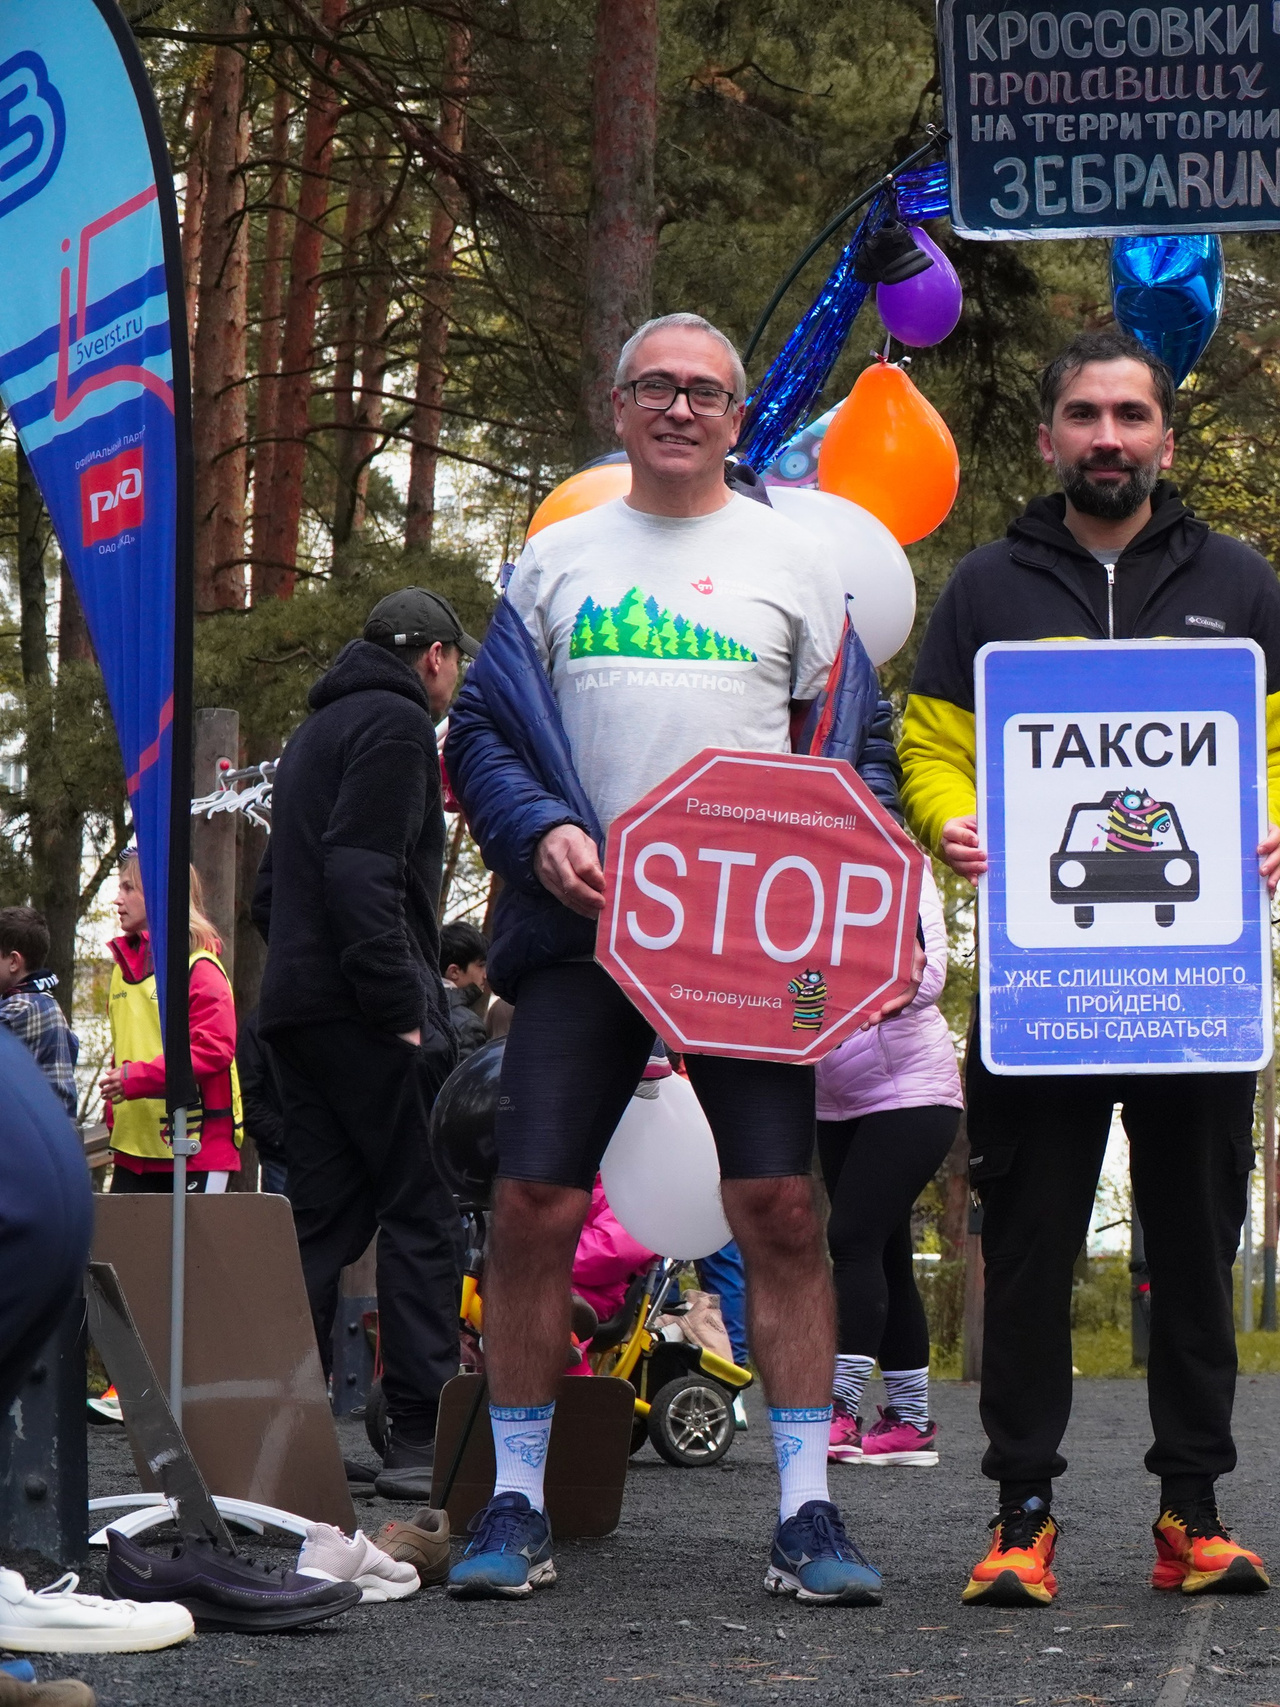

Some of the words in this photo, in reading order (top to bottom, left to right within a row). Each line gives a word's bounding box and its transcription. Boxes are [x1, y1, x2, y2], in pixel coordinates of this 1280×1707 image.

[966, 4, 1260, 61] КРОССОВКИ
[971, 113, 1016, 142] НА
[1028, 108, 1280, 142] ТЕРРИТОРИИ
[76, 315, 142, 365] 5verst.ru
[98, 543, 117, 555] ОАО
[1195, 617, 1224, 630] Columbia
[575, 670, 622, 694] HALF
[626, 670, 746, 697] MARATHON
[1018, 721, 1217, 769] ТАКСИ
[686, 797, 857, 831] Разворачивайся!!!
[626, 841, 893, 967] STOP
[1004, 970, 1052, 989] УЖЕ
[1057, 968, 1168, 988] СЛИШКОМ
[1175, 966, 1247, 985] МНОГО
[669, 983, 705, 1003] Это
[706, 988, 783, 1010] ловушка
[1067, 989, 1186, 1015] ПРОЙДЕНО,
[1025, 1021, 1099, 1041] ЧТОБЫ
[1104, 1019, 1227, 1041] СДАВАТЬСЯ
